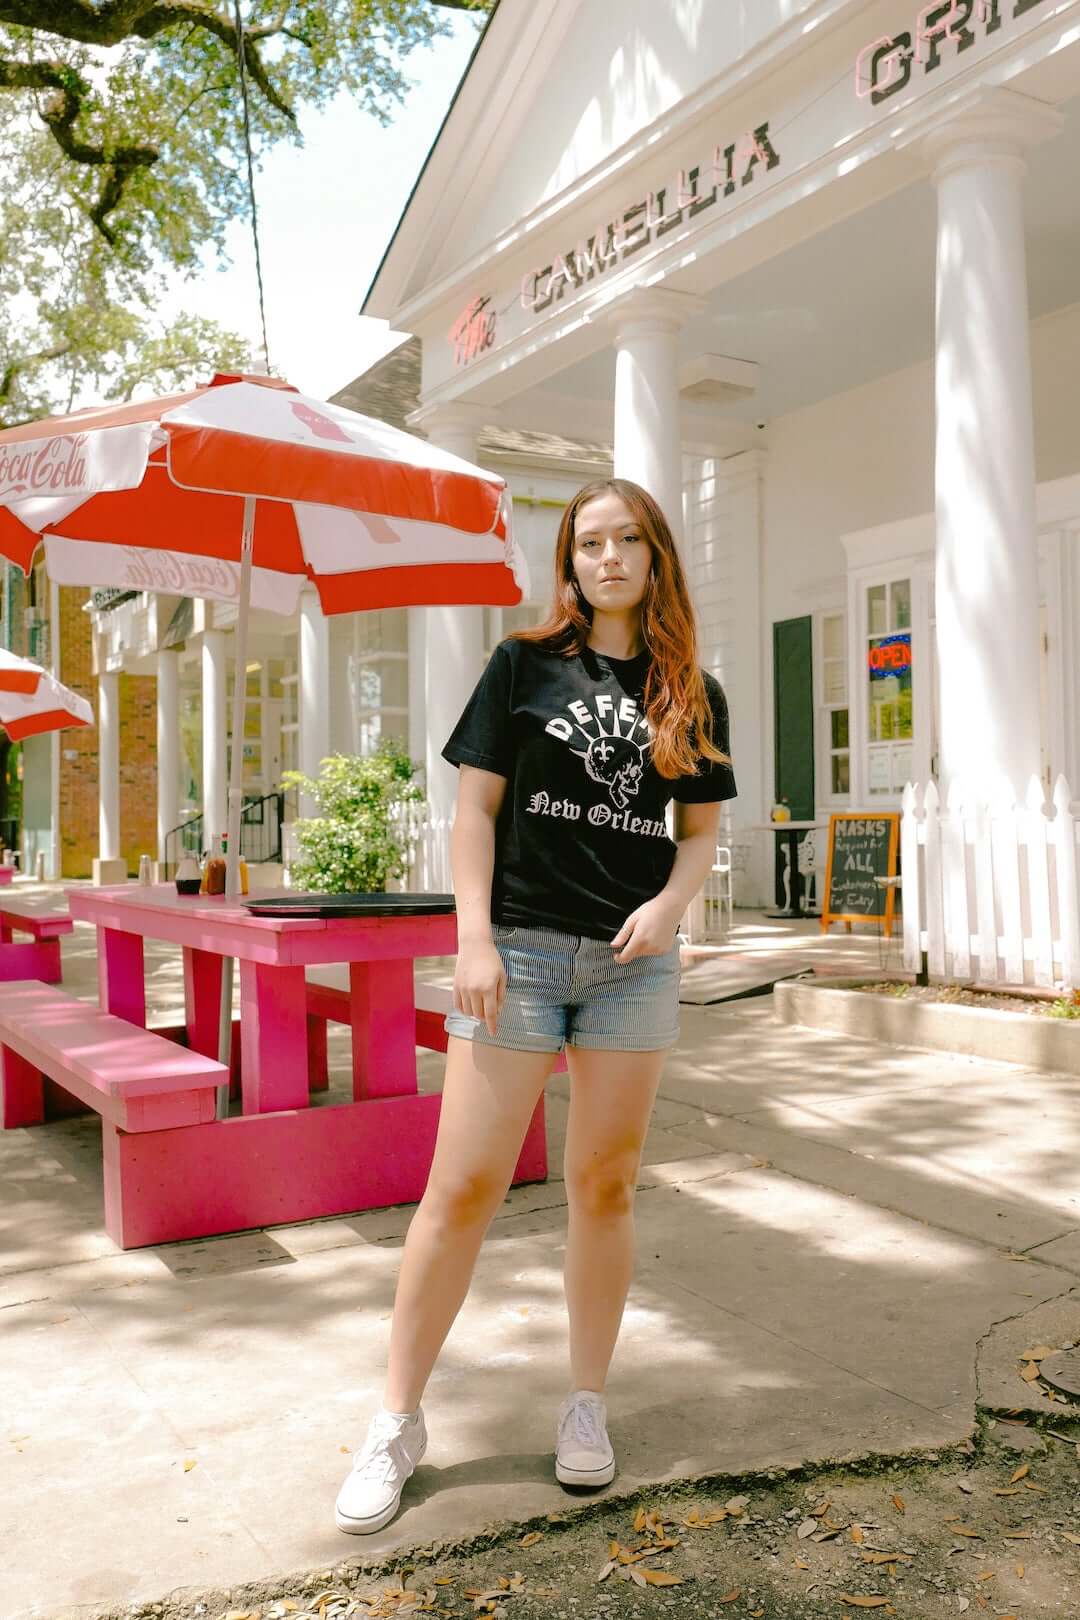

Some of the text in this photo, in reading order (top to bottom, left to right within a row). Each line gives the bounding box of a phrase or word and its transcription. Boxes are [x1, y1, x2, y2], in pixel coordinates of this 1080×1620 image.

[520, 122, 780, 314] CAMELLIA
[869, 643, 912, 669] OPEN
[545, 694, 653, 742] DEFE
[526, 791, 581, 821] New
[835, 820, 886, 837] MASKS
[843, 853, 874, 873] ALL
[847, 893, 874, 914] Entry
